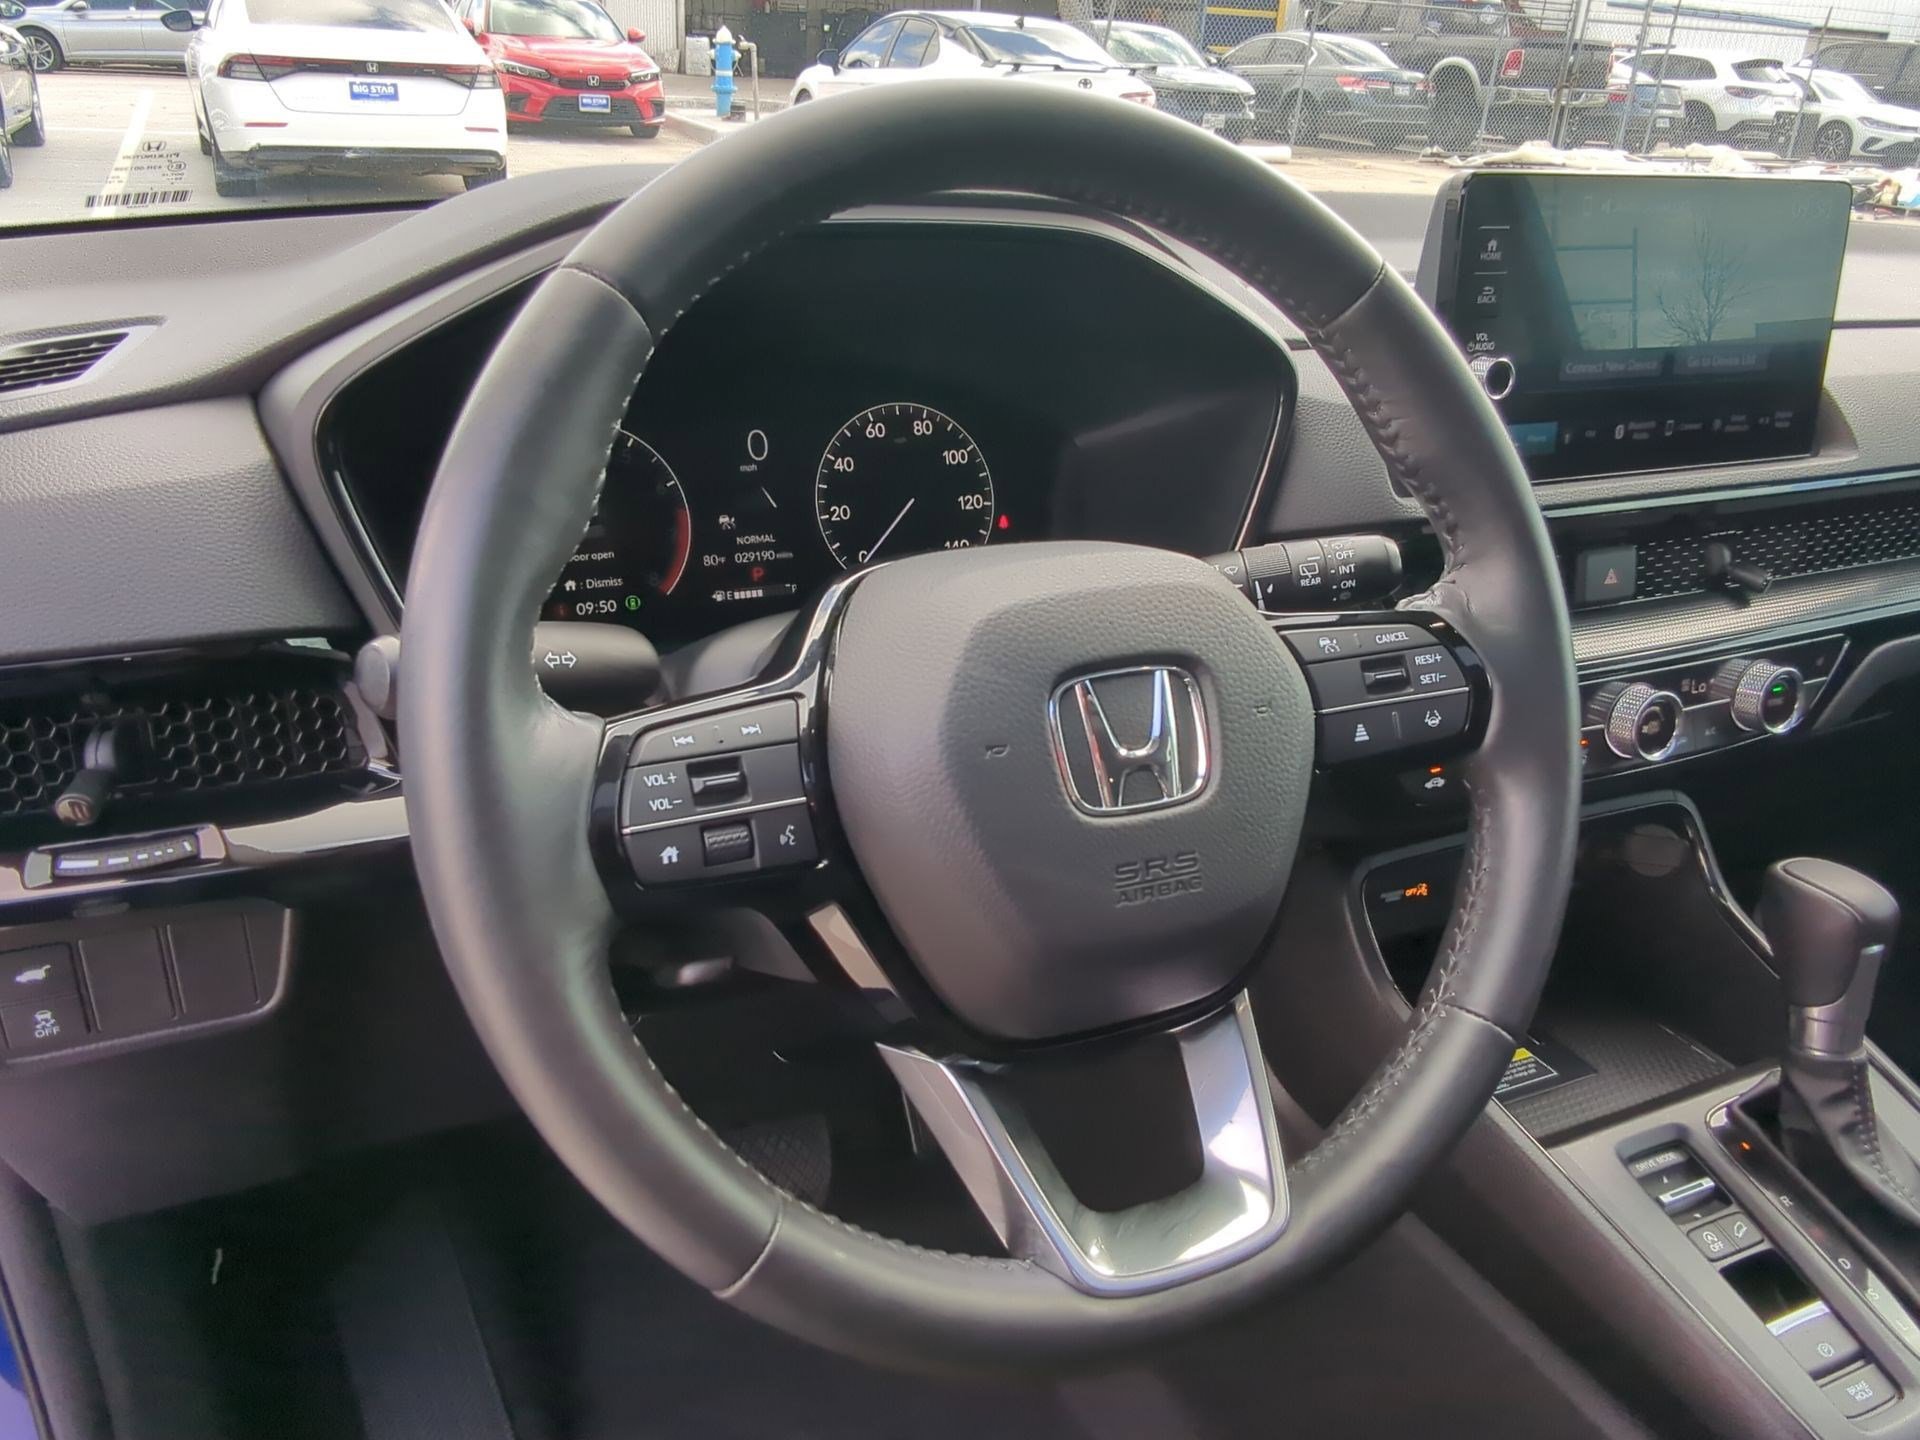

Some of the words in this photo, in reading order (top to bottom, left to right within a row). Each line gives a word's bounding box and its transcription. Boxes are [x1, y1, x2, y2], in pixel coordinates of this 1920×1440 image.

[352, 84, 369, 94] BIG
[370, 85, 395, 96] STAR
[1480, 252, 1501, 260] HOME
[1477, 295, 1496, 304] BACK
[1476, 333, 1488, 341] VOL
[1475, 342, 1495, 350] AUDIO
[866, 422, 886, 438] 60
[913, 420, 933, 436] 80
[747, 429, 768, 461] 0
[942, 449, 968, 465] 100
[739, 464, 758, 472] mph
[833, 456, 854, 472] 40
[957, 494, 983, 510] 120
[830, 504, 851, 521] 20
[736, 533, 776, 545] NORMAL
[591, 551, 615, 561] open
[735, 550, 775, 564] 029190
[1336, 549, 1355, 560] OFF
[752, 567, 764, 581] P
[1338, 563, 1356, 575] INT
[585, 576, 624, 590] Dismiss
[1300, 576, 1322, 587] REAR
[1340, 579, 1356, 589] ON
[726, 590, 733, 600] E
[576, 600, 617, 616] 09:50
[1375, 631, 1409, 644] CANCEL
[1414, 653, 1443, 666] RES/+
[643, 771, 678, 787] VOL+
[1114, 850, 1200, 887] SRS
[1114, 874, 1203, 908] AIRBAG
[35, 1026, 61, 1039] OFF
[1635, 1160, 1657, 1172] DRIVE
[1656, 1151, 1678, 1165] MODE
[1780, 1195, 1794, 1208] R
[1710, 1240, 1725, 1252] OFF
[1838, 1257, 1851, 1269] D
[1867, 1287, 1880, 1300] S
[1847, 1380, 1870, 1396] BRAKE
[1855, 1388, 1873, 1401] HOLD
